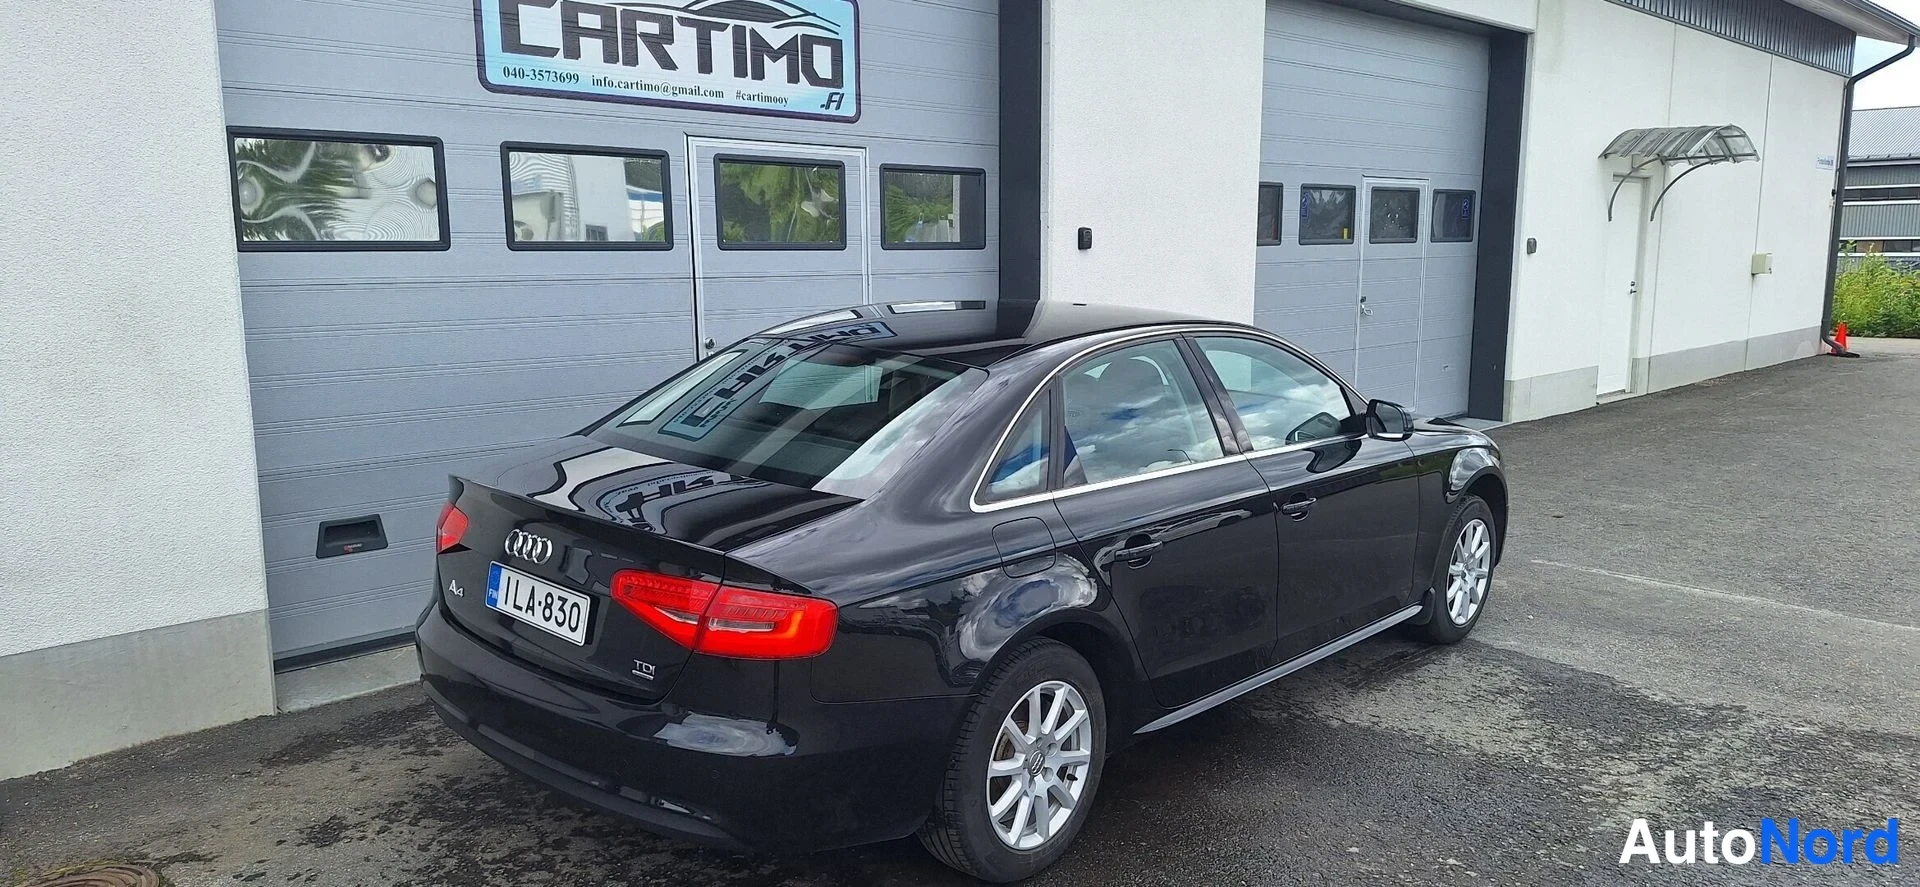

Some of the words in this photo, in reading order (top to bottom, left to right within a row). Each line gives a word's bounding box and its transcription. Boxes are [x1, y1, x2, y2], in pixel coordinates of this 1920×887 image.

[499, 0, 844, 89] CARTIMO
[502, 65, 580, 85] 040-3573699
[591, 74, 725, 99] info.cartimo@gmail.com
[735, 89, 789, 107] #cartimooy
[448, 579, 465, 599] A4
[504, 575, 582, 633] ILA-830
[633, 659, 656, 676] TDI
